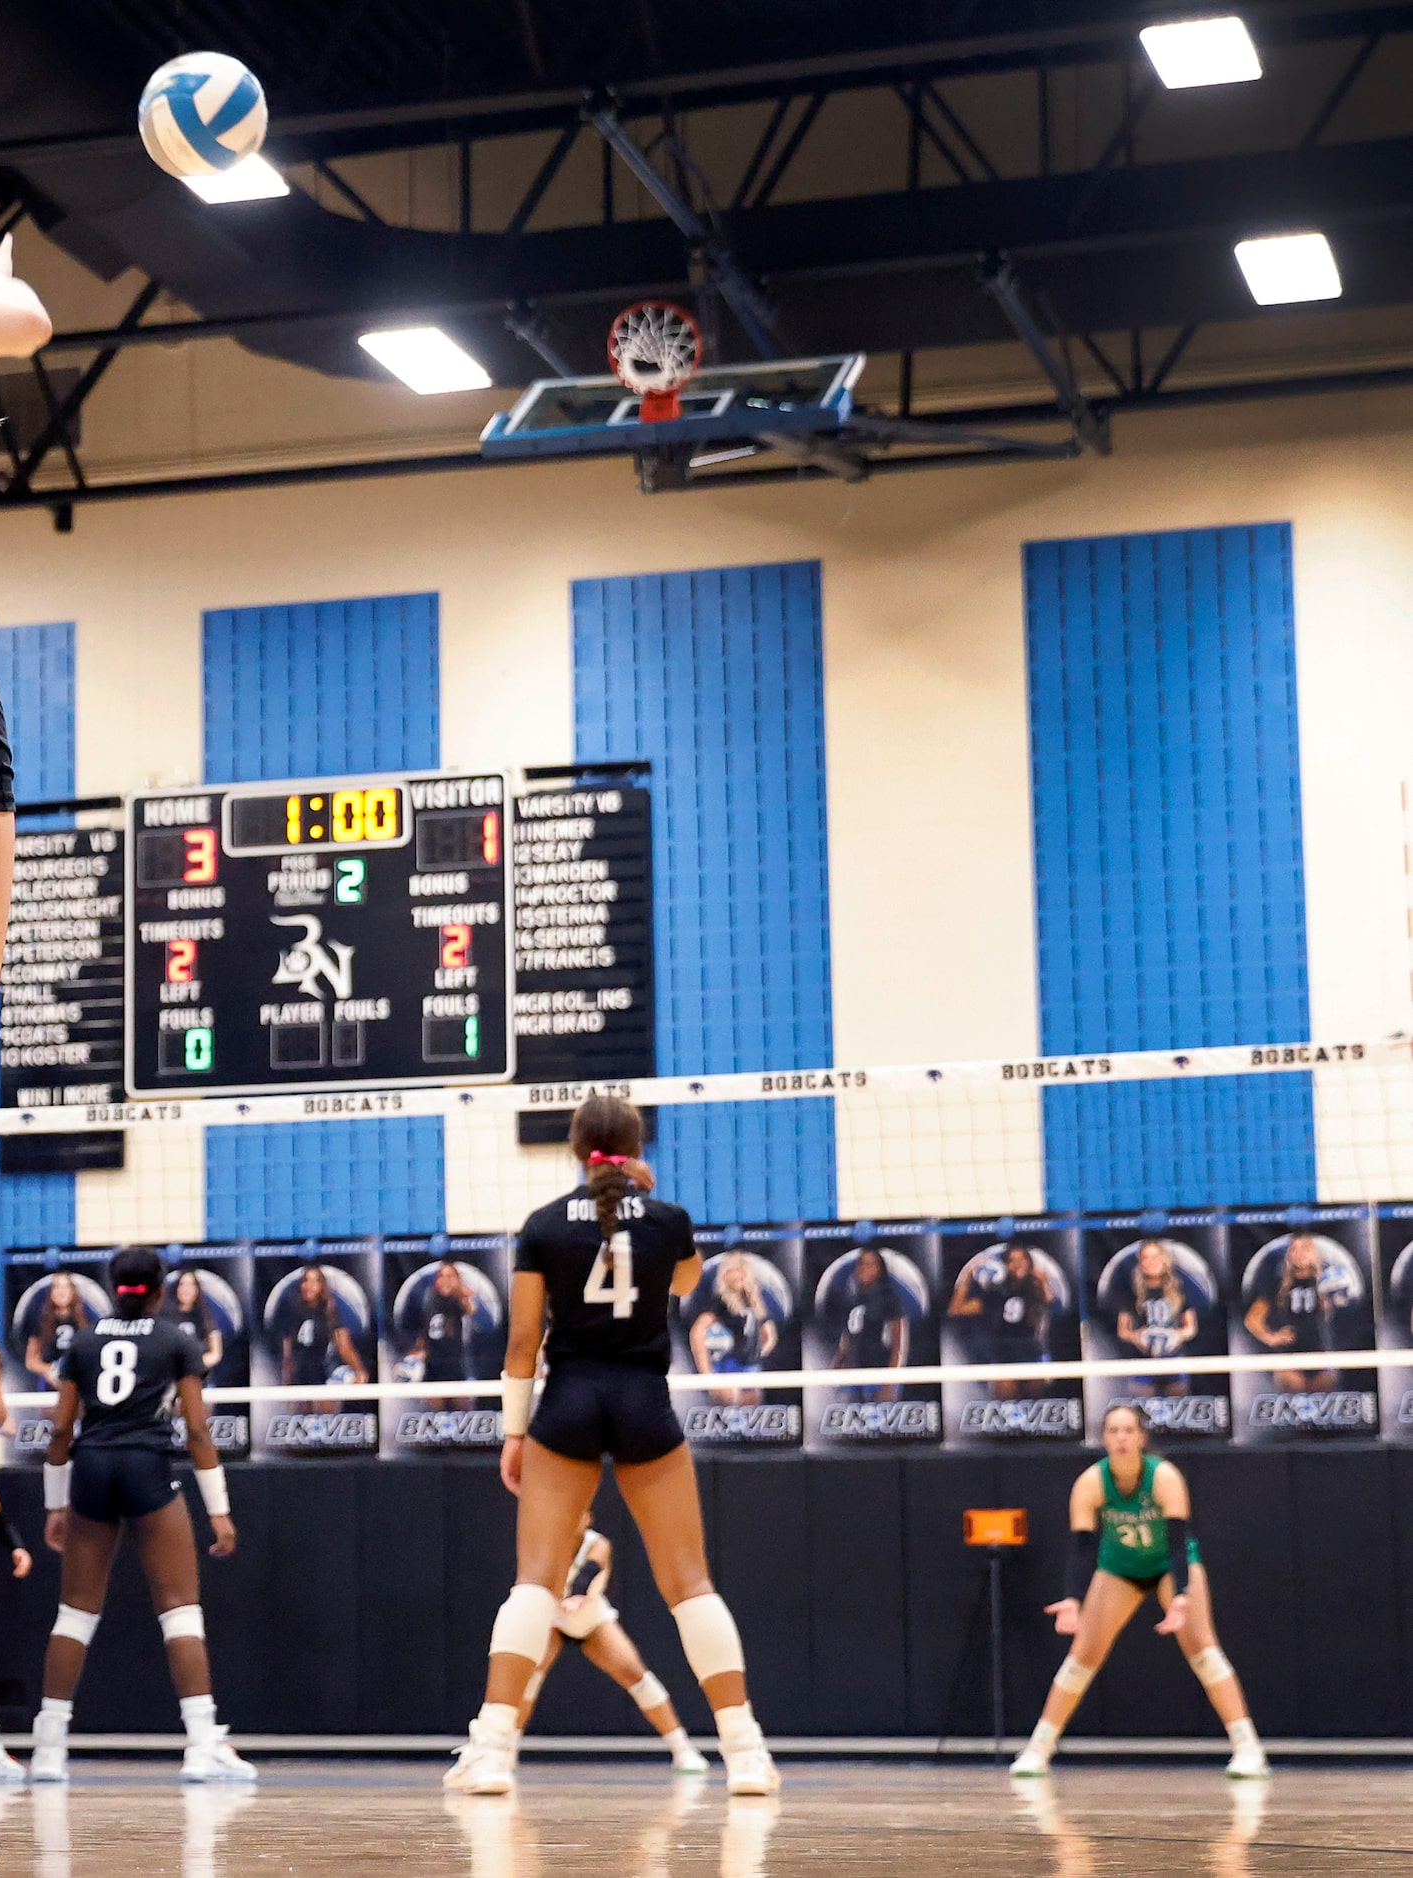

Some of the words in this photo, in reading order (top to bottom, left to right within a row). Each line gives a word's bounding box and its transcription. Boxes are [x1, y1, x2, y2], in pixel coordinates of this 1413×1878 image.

[410, 776, 503, 810] VISITOR
[518, 792, 595, 818] VARSITY
[595, 790, 623, 814] VB
[144, 796, 211, 827] HOME
[287, 787, 397, 845] 1:00
[15, 832, 77, 857] ARSITY
[89, 831, 117, 853] VB
[483, 811, 499, 865] 1
[183, 828, 217, 883] 3
[267, 868, 332, 893] PERIOD
[337, 858, 366, 904] 2
[409, 871, 470, 897] BONUS
[167, 886, 226, 911] BONUS
[411, 901, 501, 929] TIMEOUTS
[139, 917, 226, 944] TIMEOUTS
[441, 923, 473, 969] 2
[167, 939, 198, 983] 2
[434, 965, 479, 990] LEFT
[159, 980, 203, 1003] LEFT
[513, 992, 552, 1013] MGR
[259, 1001, 326, 1026] PLAYER
[334, 997, 391, 1022] FOULS
[422, 992, 480, 1018] FOULS
[159, 1006, 215, 1031] FOULS
[513, 1013, 552, 1036] MGR
[186, 1027, 213, 1071] 0
[465, 1015, 480, 1058] 1
[1250, 1045, 1365, 1066] BOBCATS
[761, 1072, 868, 1092] BOBCATS
[1002, 1059, 1111, 1080] BOBCATS
[17, 1087, 52, 1107] WIN
[303, 1095, 403, 1114] BOBCATS
[529, 1085, 632, 1103] BOBCATS
[86, 1103, 182, 1122] BOBCATS
[583, 1230, 639, 1319] 4
[56, 1324, 75, 1350] 2
[96, 1340, 138, 1406] 8
